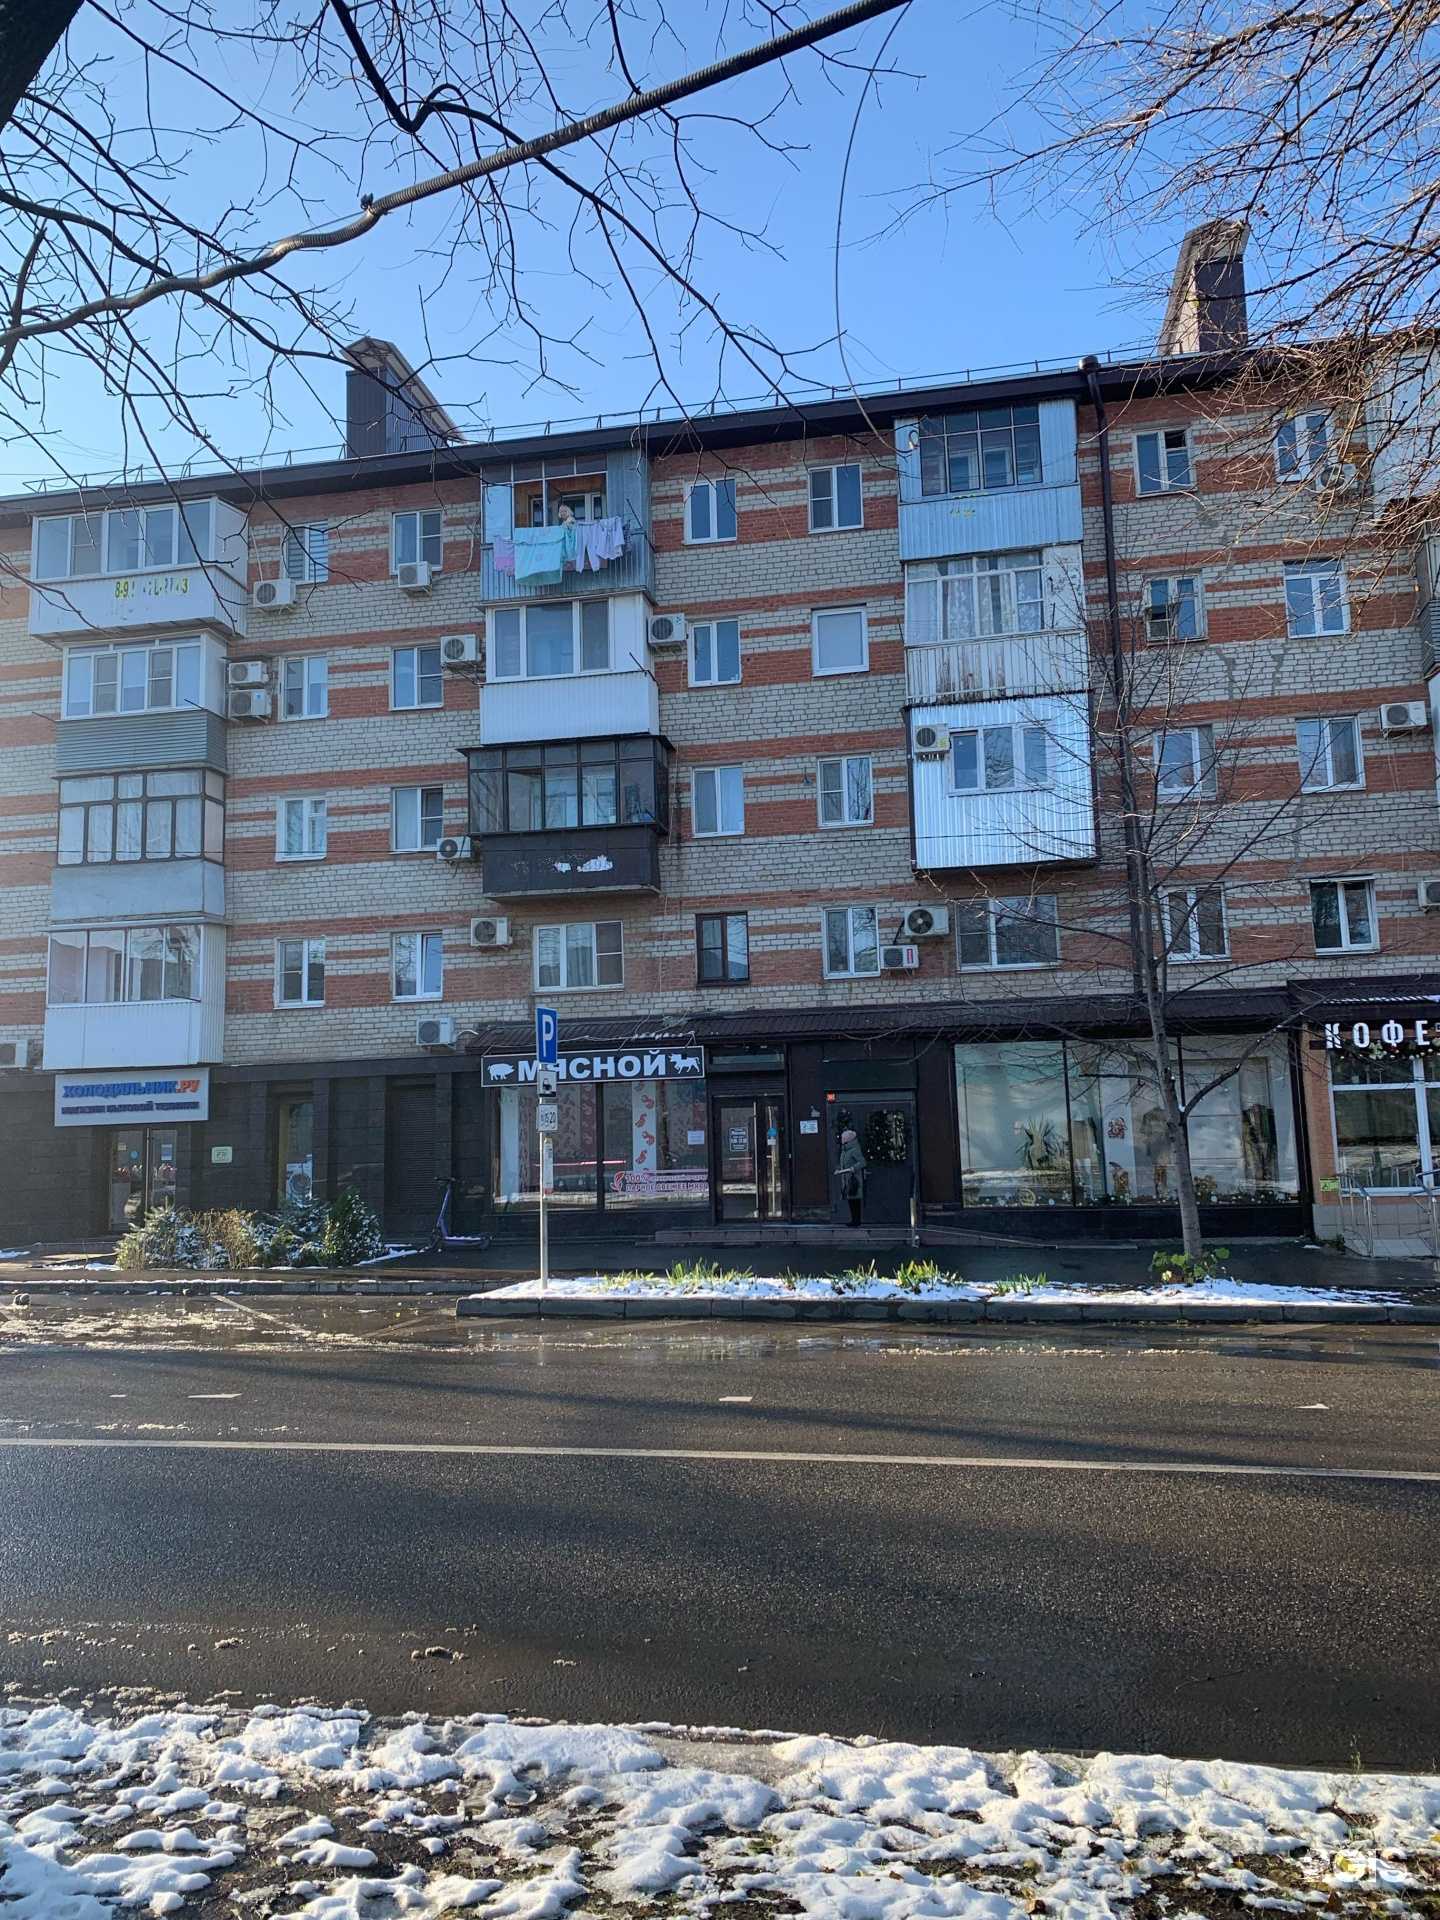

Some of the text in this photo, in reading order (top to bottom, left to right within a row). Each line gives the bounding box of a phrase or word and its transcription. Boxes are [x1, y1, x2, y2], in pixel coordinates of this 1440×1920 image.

[542, 1015, 554, 1057] P
[1324, 1018, 1431, 1049] КОФЕ
[62, 1079, 201, 1099] ХОЛОДИЛЬНИК.РУ
